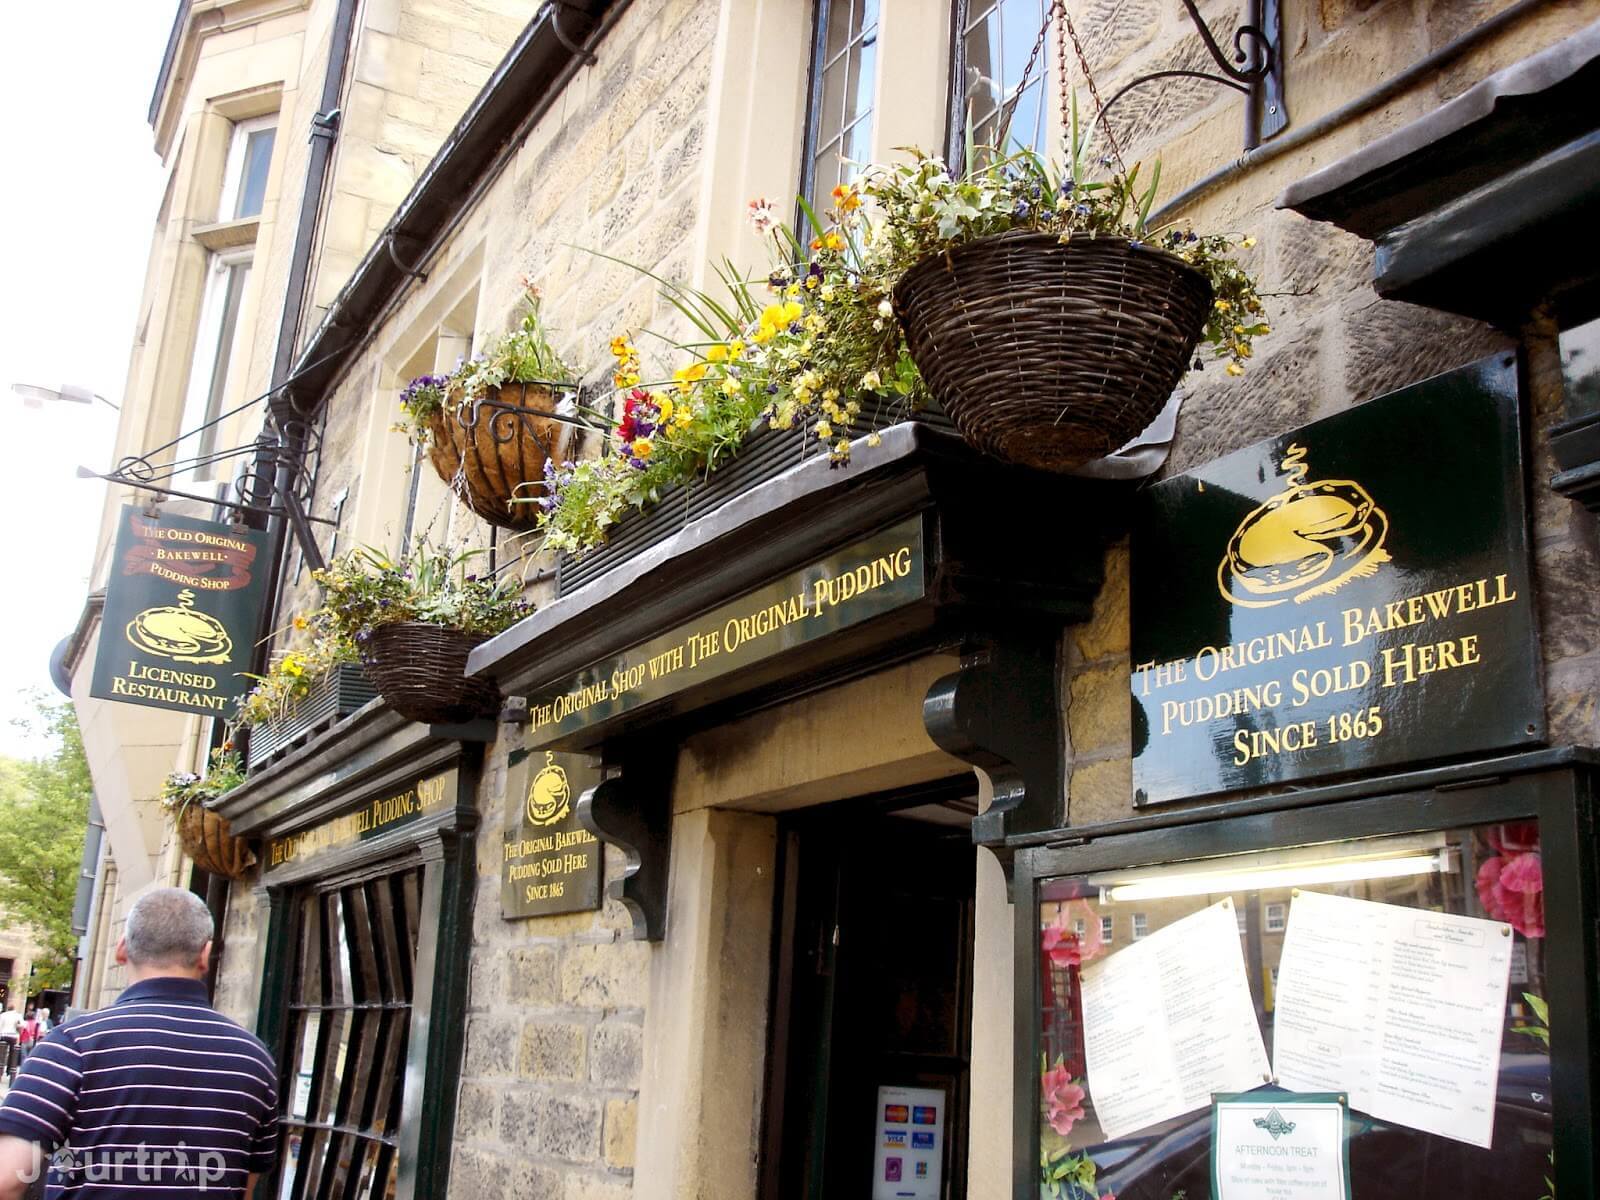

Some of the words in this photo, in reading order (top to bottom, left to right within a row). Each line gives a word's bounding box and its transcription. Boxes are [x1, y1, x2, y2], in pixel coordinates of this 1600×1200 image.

[142, 526, 165, 539] THE
[167, 529, 192, 541] OLD
[194, 532, 247, 552] ORIGINAL
[151, 563, 199, 586] PUDDING
[200, 577, 230, 590] SHOP
[530, 706, 551, 733] THE
[553, 680, 609, 723] ORIGINAL
[612, 663, 645, 700] SHOP
[648, 646, 684, 680] WITH
[688, 630, 720, 669] THE
[723, 592, 809, 654] ORIGINAL
[813, 546, 911, 618] PUDDING
[1137, 658, 1187, 697] THE
[1194, 621, 1332, 681] ORIGINAL
[1341, 573, 1517, 647] BAKEWELL
[128, 661, 216, 690] LICENSED
[1161, 682, 1282, 736] PUDDING
[1291, 660, 1371, 708] SOLD
[1381, 635, 1481, 688] HERE
[112, 677, 227, 710] RESTAURANT
[1233, 721, 1318, 767] SINCE
[1326, 706, 1383, 743] 1865
[373, 790, 413, 828] PUDDING
[416, 777, 446, 810] SHOP
[505, 843, 518, 861] THE
[519, 836, 554, 858] ORIGINAL
[509, 863, 540, 883] PUDDING
[542, 858, 562, 878] SOLD
[564, 854, 588, 874] HERE
[526, 884, 548, 903] SINCE
[549, 882, 564, 897] 1865
[1235, 1145, 1288, 1157] AFTERNOON
[1290, 1146, 1318, 1157] TREAT
